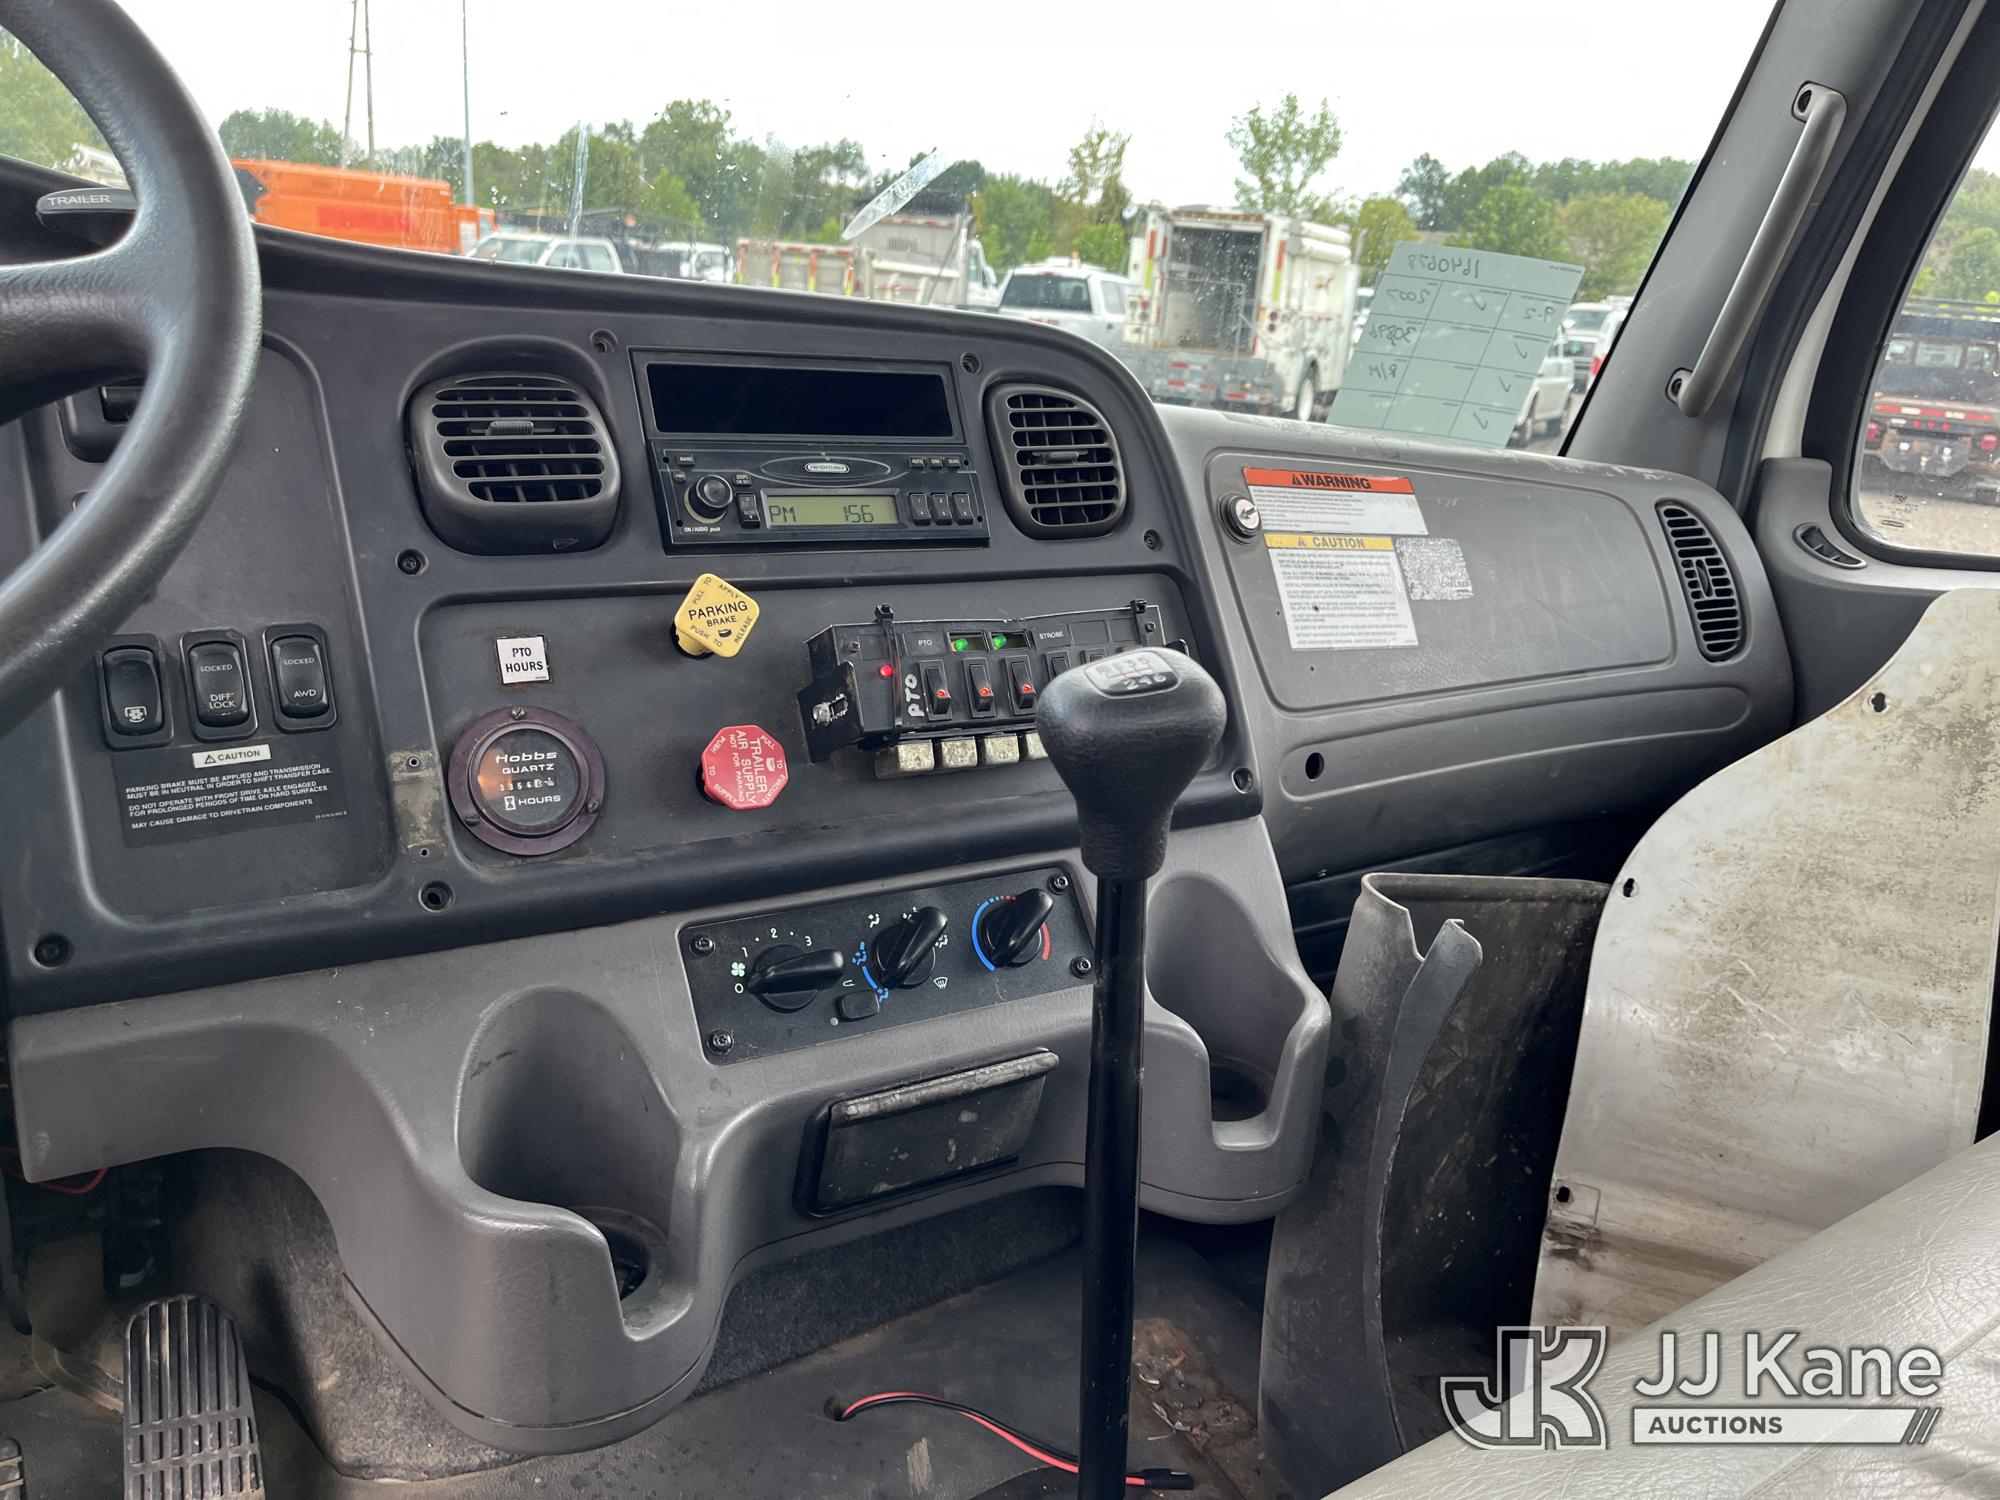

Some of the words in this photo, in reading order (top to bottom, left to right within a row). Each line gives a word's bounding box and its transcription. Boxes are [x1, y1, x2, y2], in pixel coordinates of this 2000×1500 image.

[47, 194, 112, 206] TRAILER
[1300, 474, 1372, 489] WARNING
[769, 506, 796, 522] PM
[1312, 536, 1366, 548] CAUTION
[693, 590, 704, 604] PULL
[704, 576, 712, 585] TO
[719, 584, 740, 598] APPLY
[688, 600, 748, 620] PARKING
[707, 616, 737, 627] BRAKE
[691, 625, 709, 639] PUSH
[714, 638, 722, 647] TO
[735, 616, 753, 644] RELEASE
[1039, 631, 1064, 639] STROBE
[512, 647, 532, 657] PTO
[200, 663, 233, 672] LOCKED
[284, 657, 315, 665] LOCKED
[506, 661, 543, 672] HOURS
[210, 692, 232, 702] DIFF
[294, 688, 316, 698] AWD
[904, 674, 925, 717] PTO
[209, 700, 235, 709] LOCK
[729, 734, 737, 749] NOT
[736, 730, 749, 750] AIR
[218, 750, 261, 762] CAUTION
[495, 752, 558, 763] Hobbs
[760, 735, 775, 750] PULL
[777, 760, 783, 769] TO
[502, 763, 554, 774] QUARTZ
[708, 765, 716, 776] TO
[750, 738, 768, 793] TRAILER
[126, 784, 159, 793] PARKING
[161, 781, 186, 789] BRAKE
[222, 772, 252, 781] APPLIED
[270, 764, 321, 774] TRANSMISSION
[171, 785, 204, 794] NEUTRAL
[216, 779, 241, 787] ORDER
[275, 771, 310, 780] TRANSFER
[741, 759, 757, 804] SUPPLY
[159, 798, 192, 807] OPERATE
[214, 791, 238, 800] FRONT
[283, 781, 317, 791] ENGAGED
[518, 795, 561, 805] HOURS
[148, 804, 193, 815] PROLONGED
[195, 800, 228, 809] PERIODS
[149, 818, 174, 827] CAUSE
[176, 814, 207, 823] DAMAGE
[221, 806, 262, 817] DRIVETRAIN
[742, 947, 748, 957] 1
[770, 928, 778, 938] 2
[804, 936, 812, 946] 3
